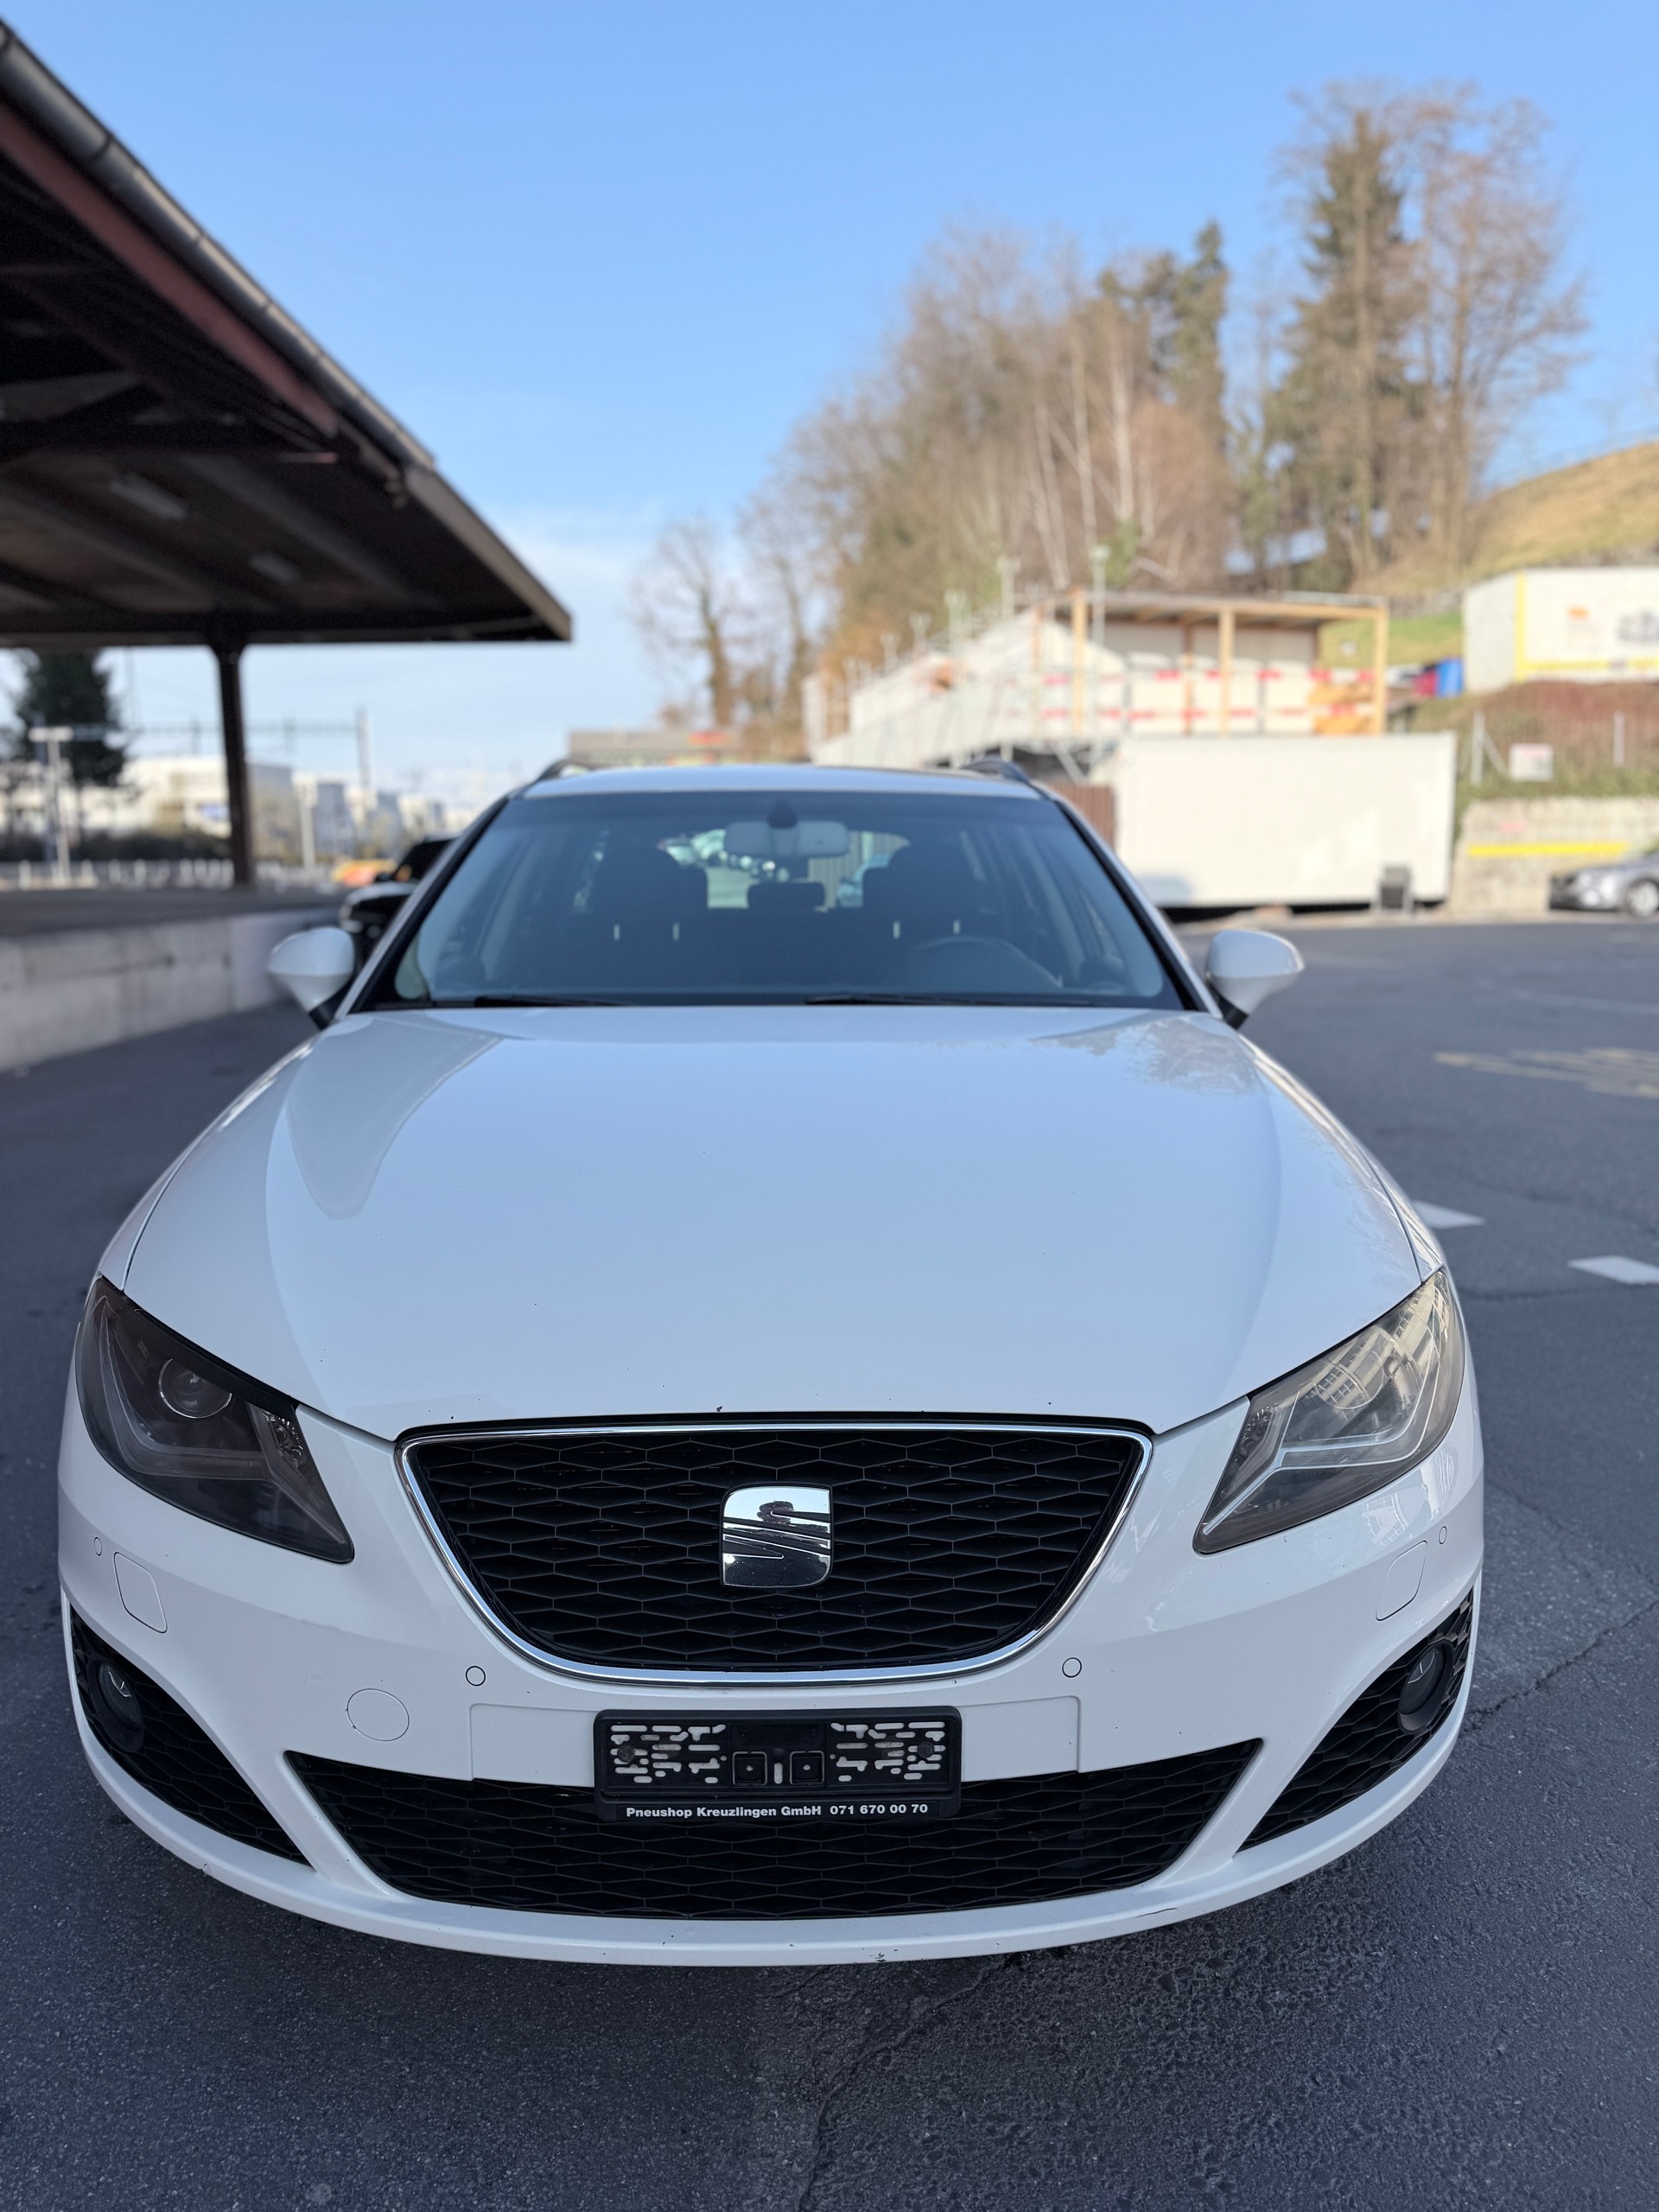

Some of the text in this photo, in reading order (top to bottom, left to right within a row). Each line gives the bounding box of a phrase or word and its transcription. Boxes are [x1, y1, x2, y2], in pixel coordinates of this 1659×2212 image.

[626, 1803, 928, 1819] Pneushop Kreuzlingen GmbH 071 670 00 70
